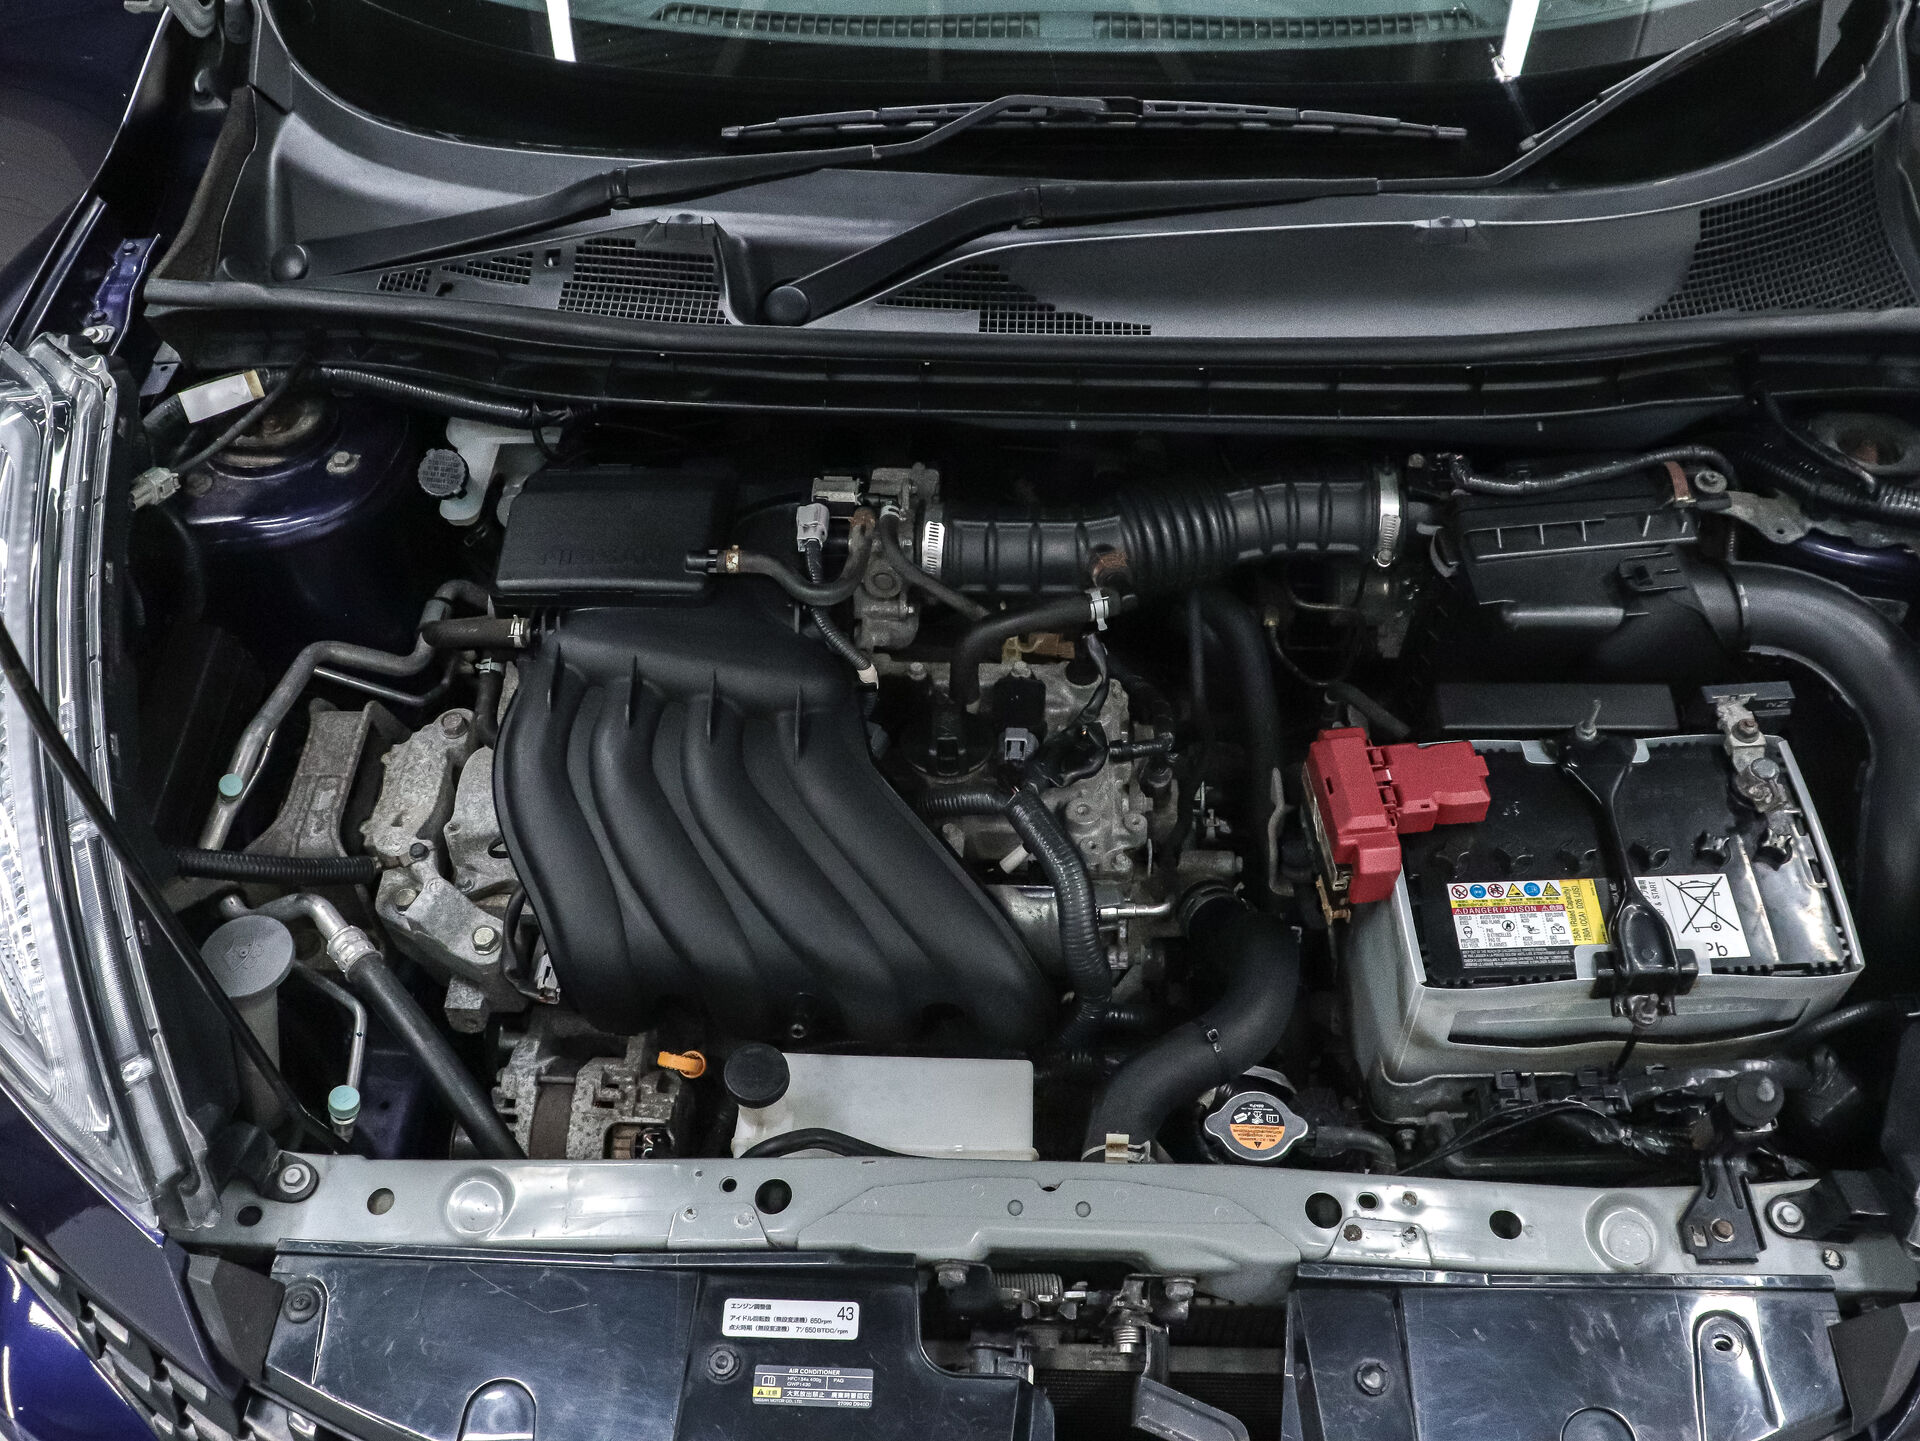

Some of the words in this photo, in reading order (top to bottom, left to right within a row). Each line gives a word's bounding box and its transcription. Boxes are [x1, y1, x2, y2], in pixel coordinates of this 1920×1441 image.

[1648, 881, 1660, 900] START
[1462, 905, 1537, 915] DANGER/POISON
[836, 1306, 854, 1321] 43
[809, 1317, 833, 1325] 650rpm
[787, 1390, 825, 1398] 大気放出禁止
